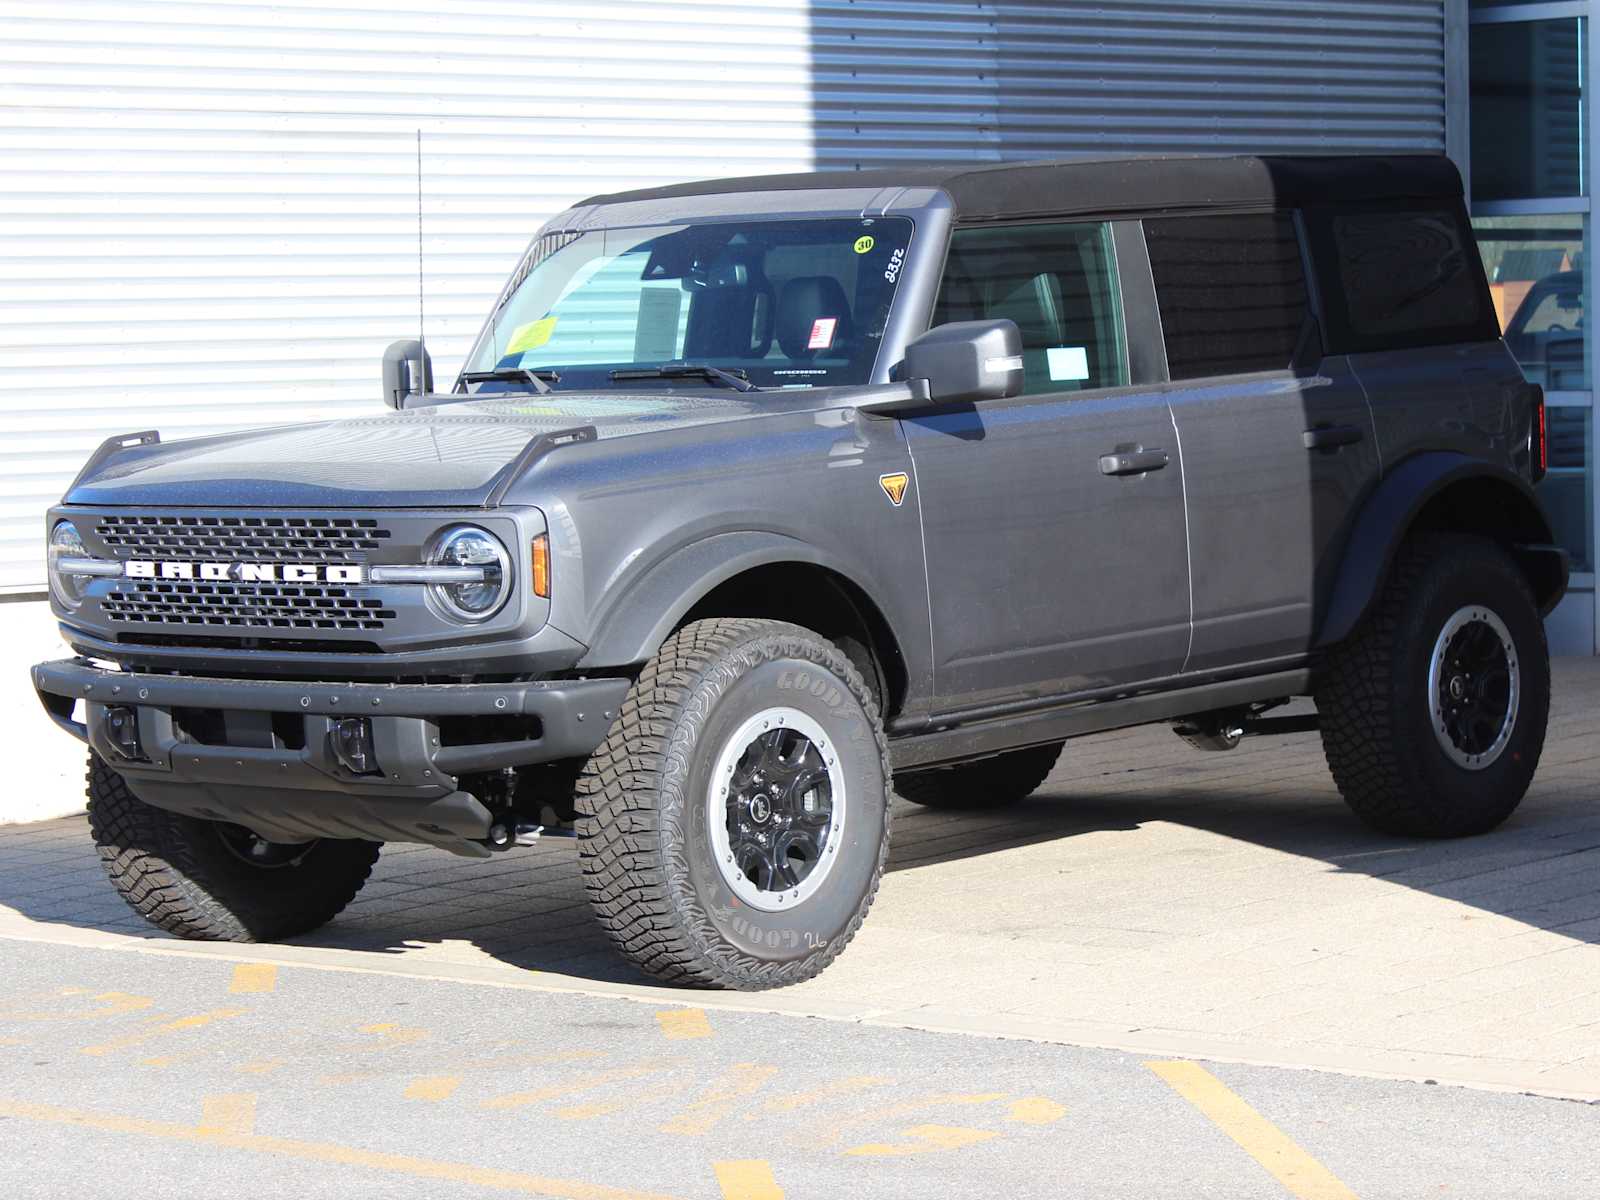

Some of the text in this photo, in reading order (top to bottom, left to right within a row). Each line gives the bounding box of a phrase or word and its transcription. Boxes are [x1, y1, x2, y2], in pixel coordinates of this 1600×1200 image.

[857, 239, 872, 251] 30
[884, 248, 905, 284] 2332
[125, 560, 362, 584] BRONCO
